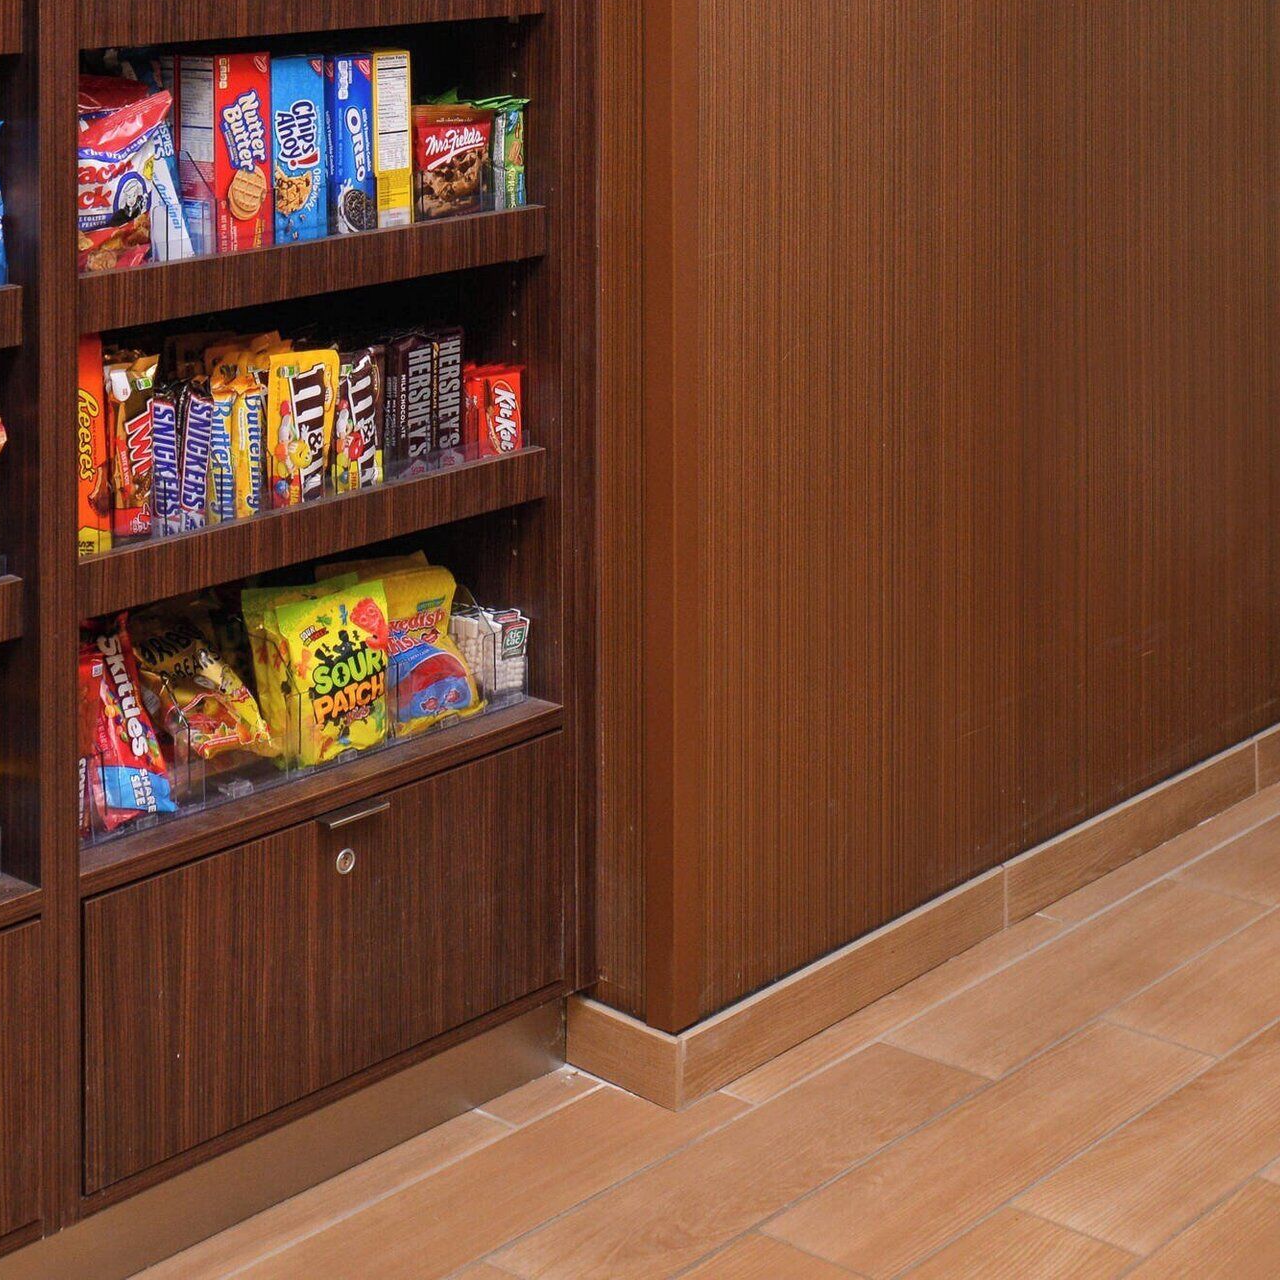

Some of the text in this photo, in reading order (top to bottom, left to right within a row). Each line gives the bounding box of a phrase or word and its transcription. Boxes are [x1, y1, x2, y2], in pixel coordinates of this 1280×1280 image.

[222, 104, 255, 173] Butter
[238, 89, 266, 163] Nutter
[290, 99, 316, 157] Chips
[346, 107, 367, 182] OREO
[78, 184, 112, 210] ck
[408, 344, 432, 458] HERSHEY'S
[438, 339, 461, 449] HERSHEY'S
[78, 389, 100, 482] Reese's
[153, 405, 182, 517] SNICKERS
[181, 397, 212, 511] SNICKERS
[505, 637, 521, 649] tac
[509, 628, 523, 640] tic
[313, 647, 385, 696] SOUR
[313, 670, 386, 724] PATCH
[129, 774, 147, 807] SIZE
[139, 768, 158, 813] SHARE
